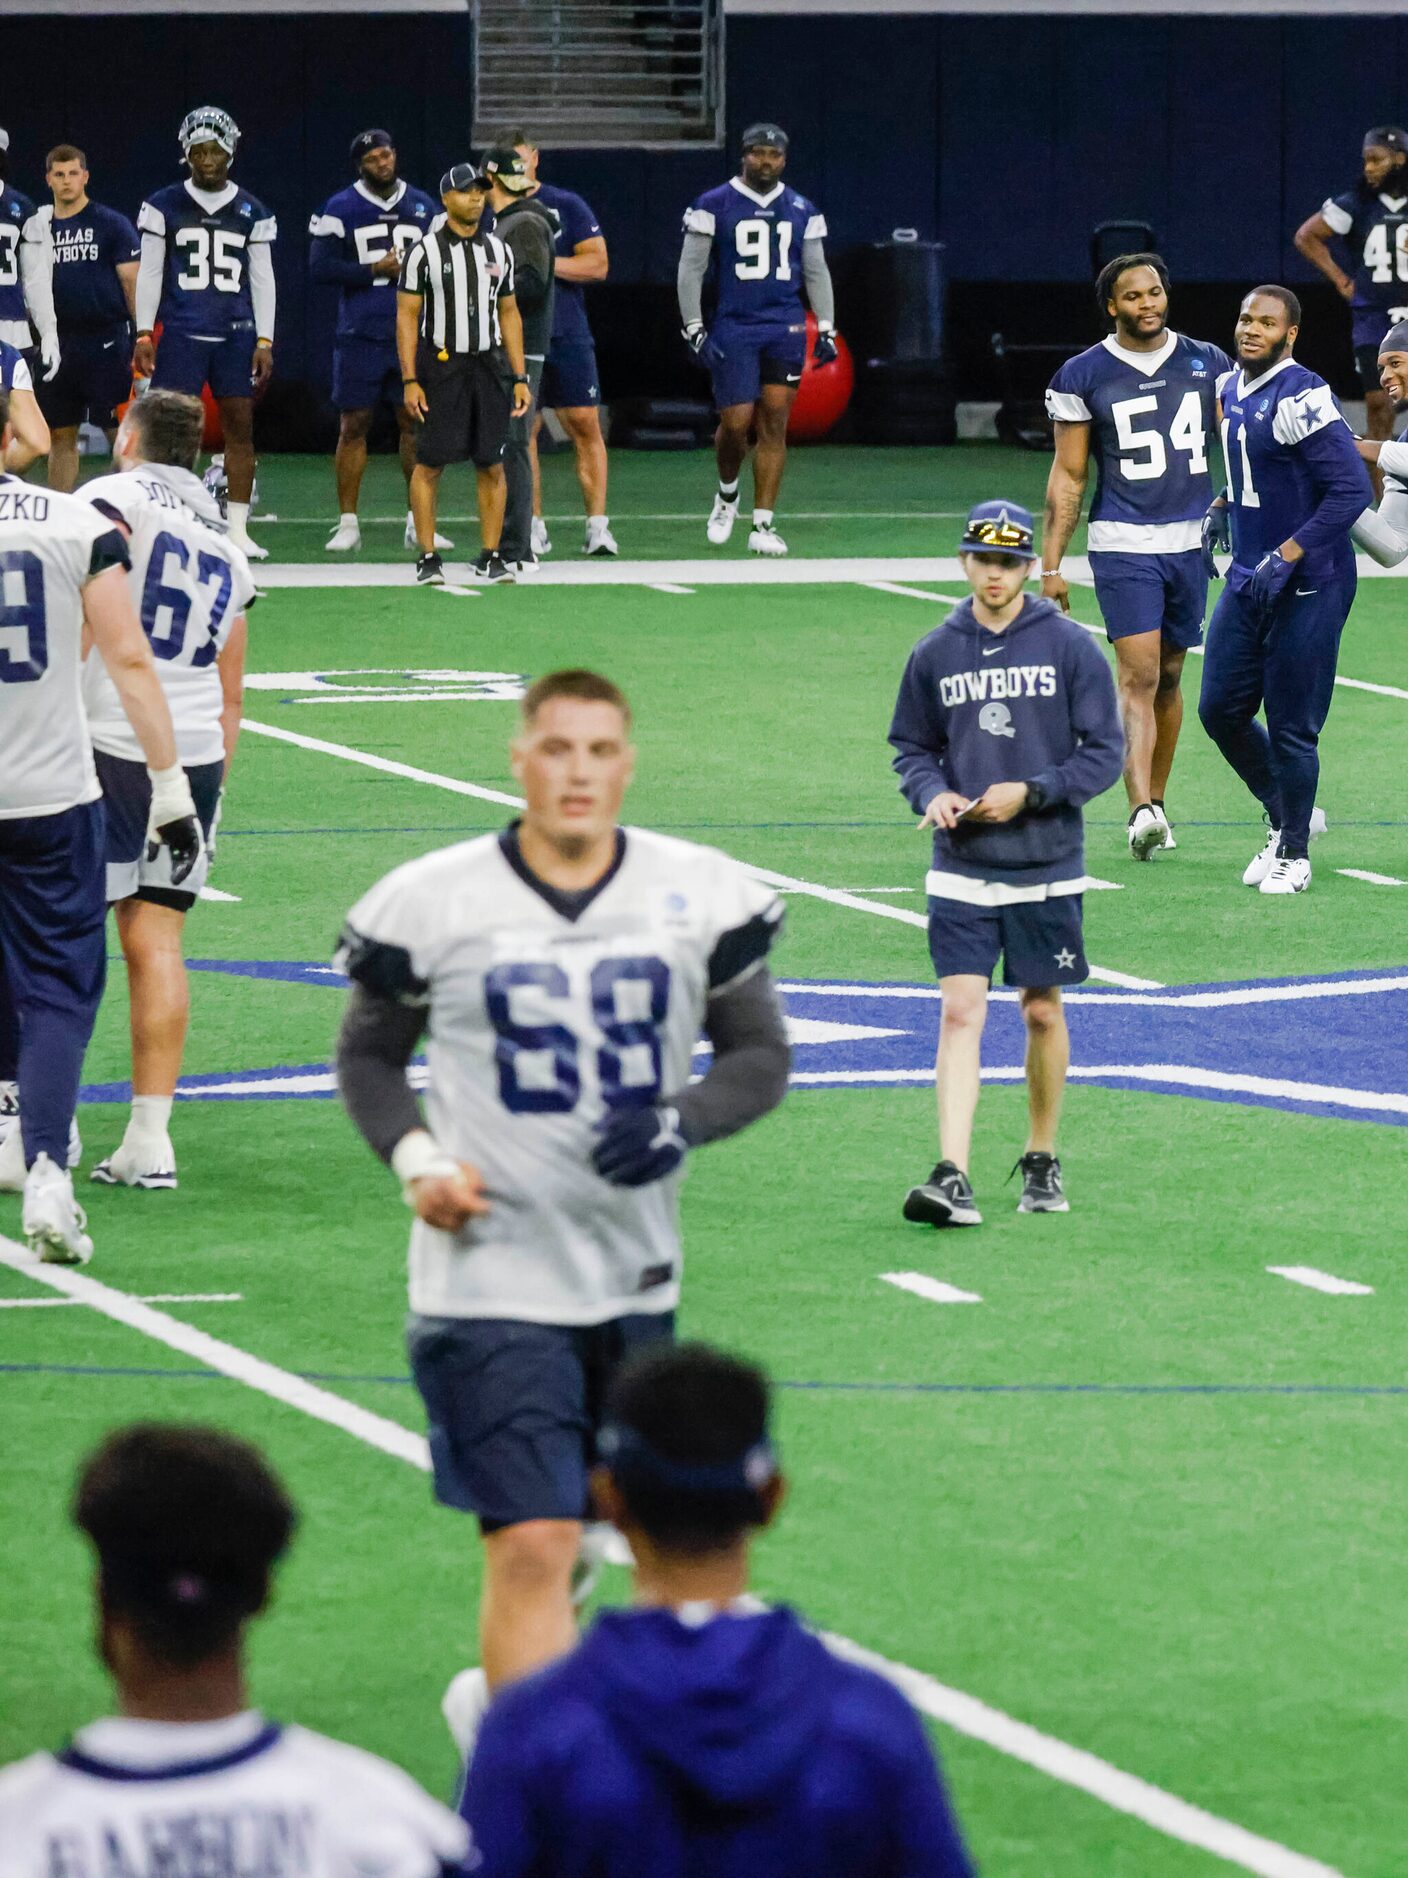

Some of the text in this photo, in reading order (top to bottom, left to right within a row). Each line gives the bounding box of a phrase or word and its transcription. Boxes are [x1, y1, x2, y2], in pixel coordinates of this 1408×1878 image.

[175, 227, 246, 293] 35
[735, 219, 792, 280] 91
[1111, 391, 1209, 481] 54
[140, 530, 232, 668] 67
[940, 666, 1057, 707] COWBOYS
[485, 956, 670, 1112] 68
